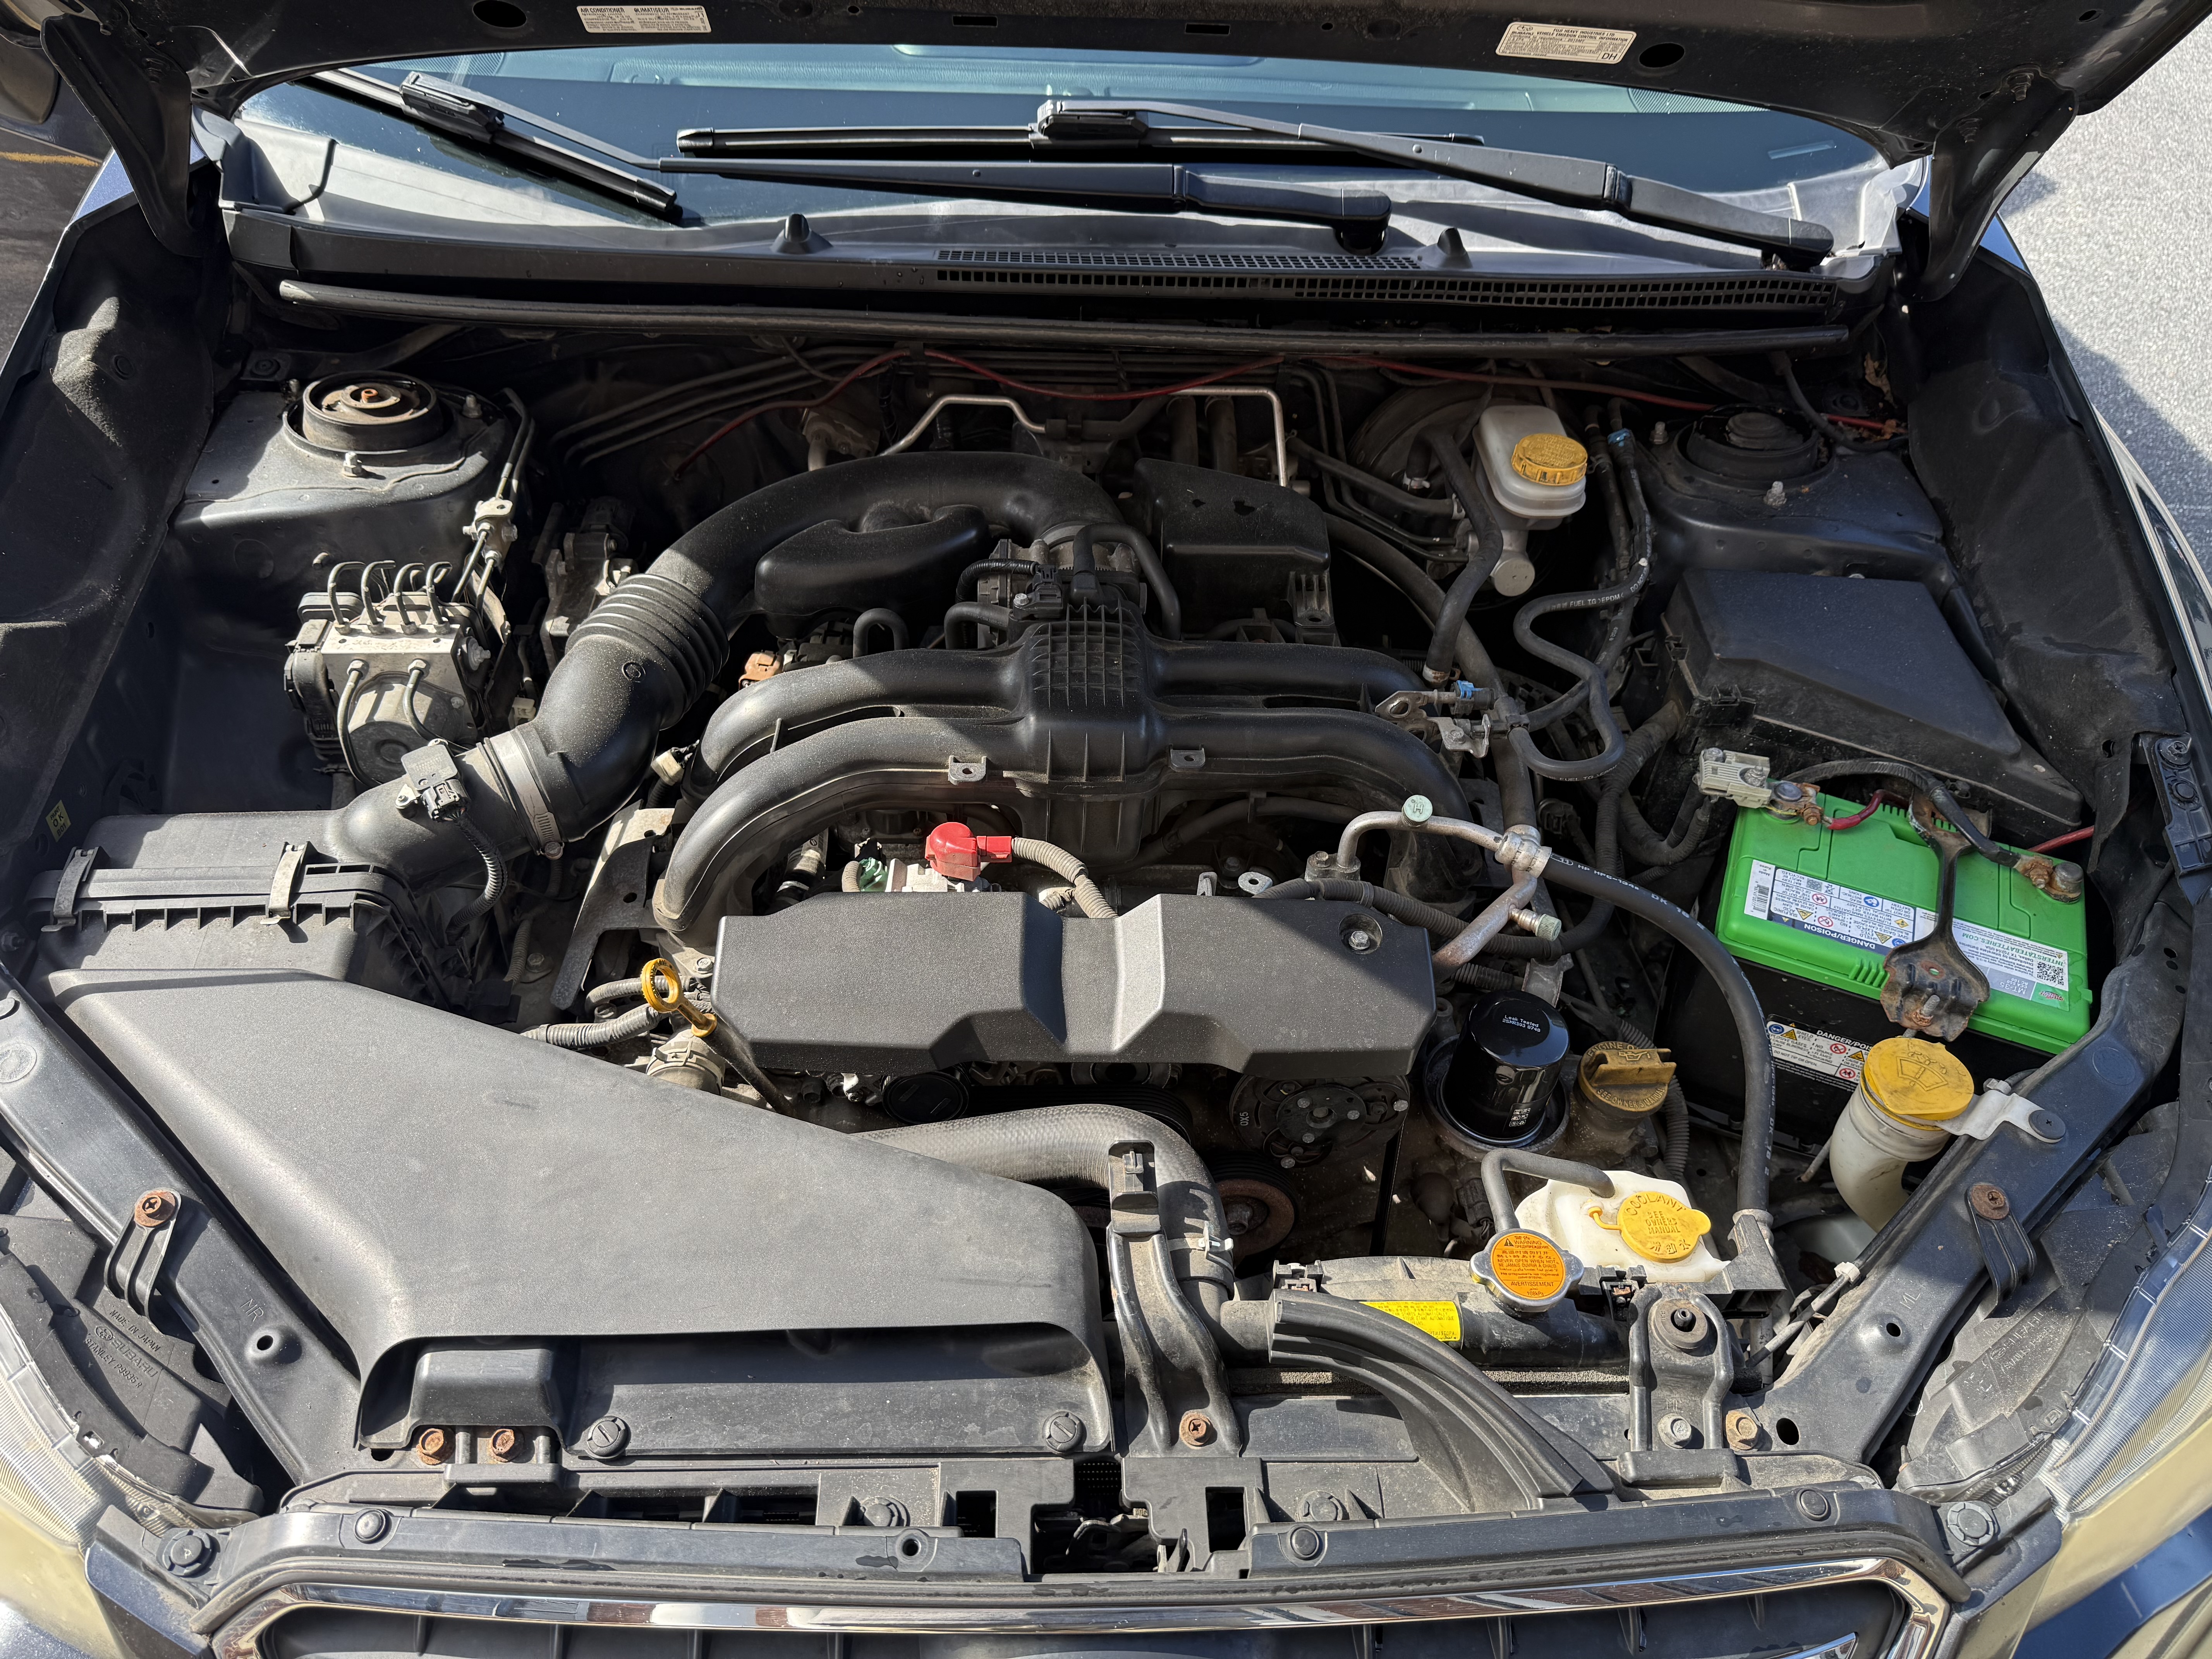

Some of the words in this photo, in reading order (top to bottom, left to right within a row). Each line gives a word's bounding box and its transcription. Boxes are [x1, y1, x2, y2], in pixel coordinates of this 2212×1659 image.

[1414, 803, 1424, 814] H
[1781, 883, 1804, 892] CHILDREN
[1651, 893, 1668, 905] DK
[1775, 897, 1799, 906] BLINDNESS
[1773, 907, 1798, 917] SULFURIC
[1833, 905, 1863, 917] IMMEDIATELY
[1891, 903, 1911, 911] BATTERY
[1872, 909, 1892, 918] MEDICAL
[1879, 927, 1896, 936] GASES
[1884, 926, 1909, 935] BLINDNESS
[1804, 923, 1875, 950] DANGER/POISON
[1859, 933, 1878, 941] SHIELD
[1959, 941, 1979, 951] Batteries
[1962, 933, 2063, 966] INTERSTATEBATTERIES.COM
[1979, 948, 2001, 957] Interstate
[2009, 957, 2033, 966] Distributed
[1999, 981, 2026, 994] MT-35
[1520, 1018, 1539, 1027] Tested
[1786, 1042, 1809, 1051] BLINDNESS
[1597, 1089, 1612, 1100] SEE
[1645, 1088, 1665, 1106] MANUAL
[1624, 1194, 1686, 1216] COOLANT
[1645, 1218, 1677, 1226] OWNERS
[1648, 1226, 1681, 1234] MANUAL
[1900, 1293, 1920, 1309] ML
[240, 1298, 264, 1322] MR
[110, 1310, 130, 1327] MADE
[128, 1325, 139, 1334] IN
[137, 1334, 161, 1352] JAPAN
[85, 1338, 116, 1364] STANLEY
[110, 1338, 158, 1377] SUBARU
